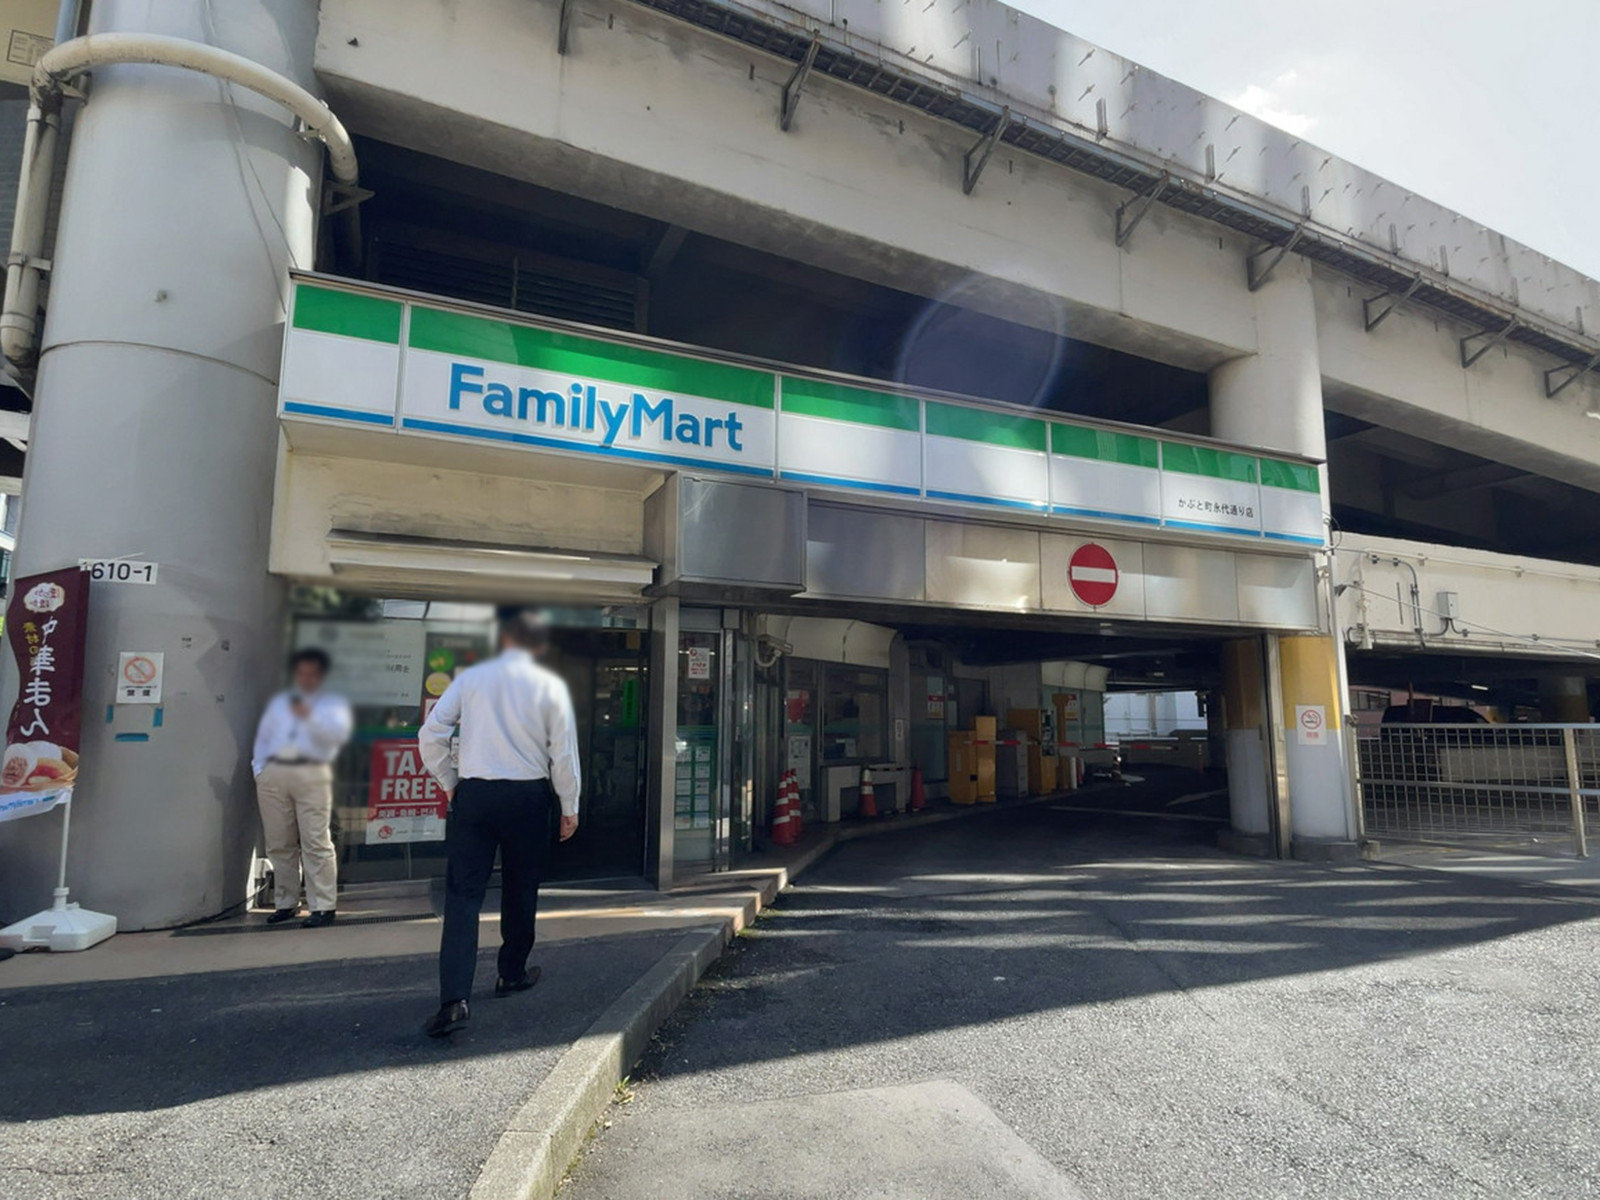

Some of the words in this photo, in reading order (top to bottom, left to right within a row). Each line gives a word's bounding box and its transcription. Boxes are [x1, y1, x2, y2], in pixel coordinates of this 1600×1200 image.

[449, 362, 743, 452] FamilyMart
[1178, 498, 1254, 518] かぶと町永代通り店
[381, 778, 437, 800] FREE
